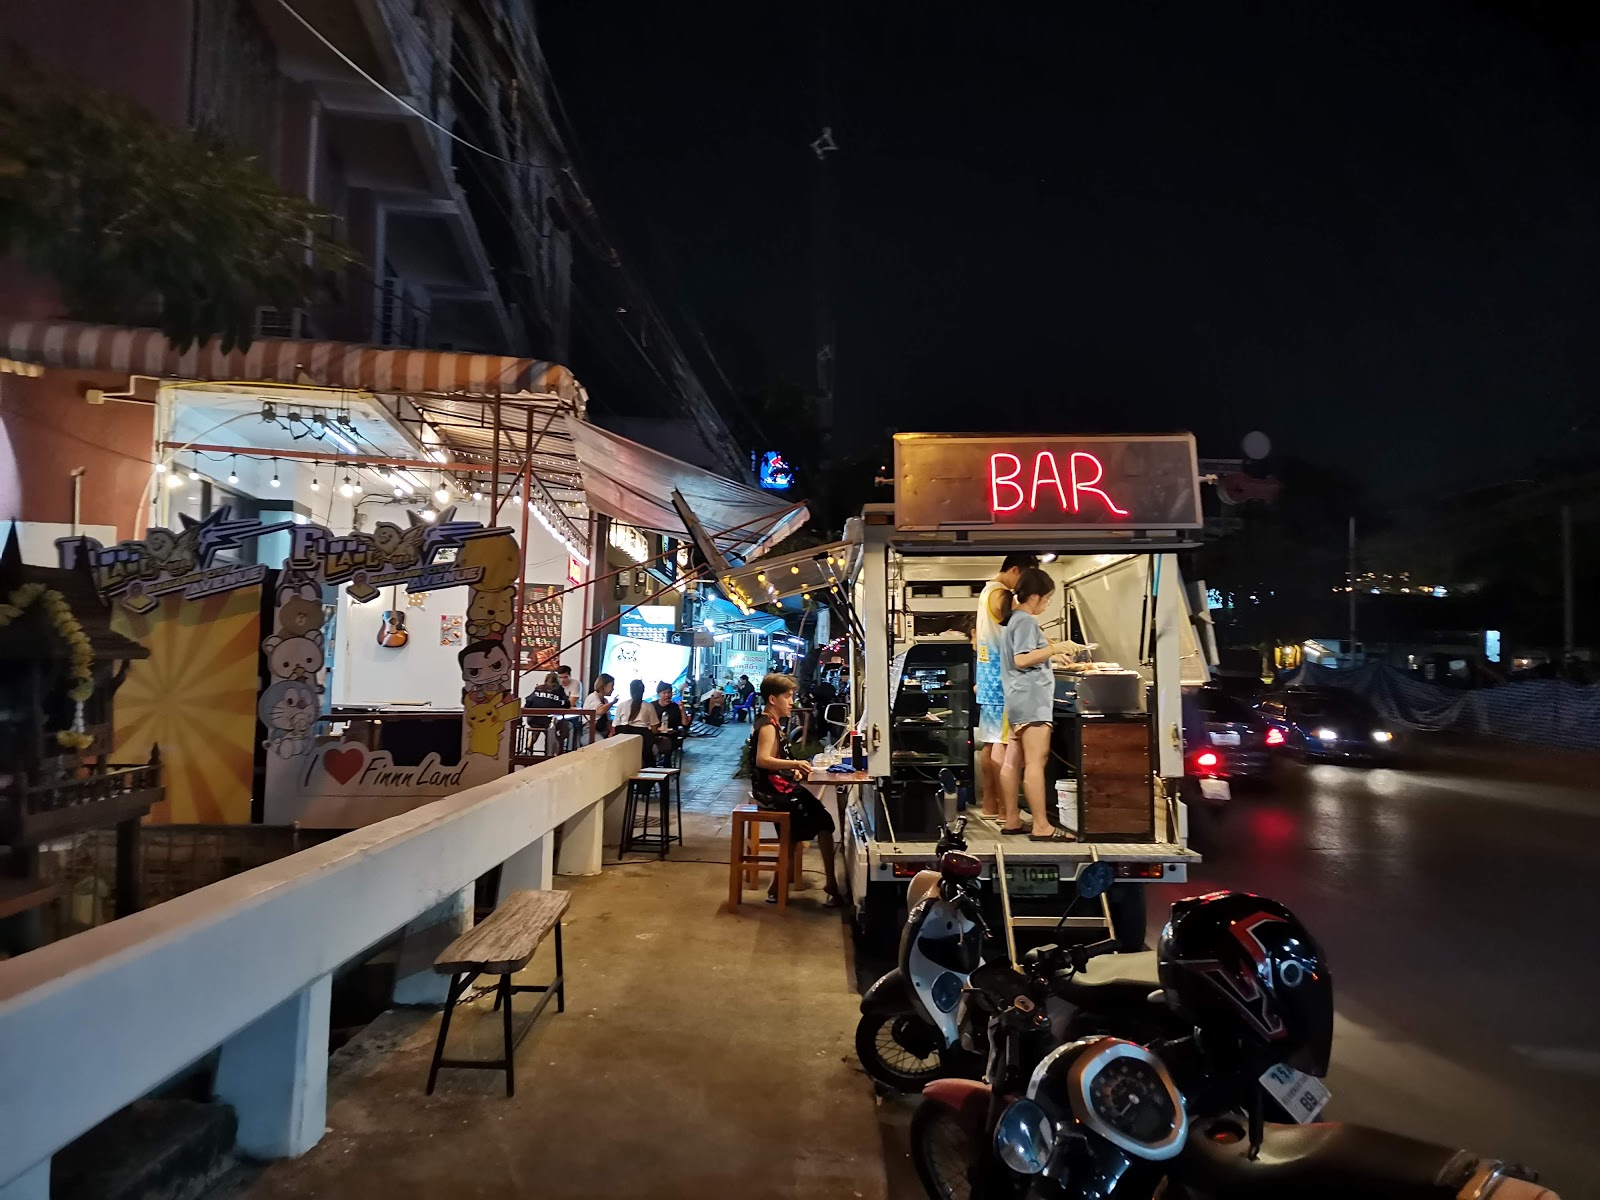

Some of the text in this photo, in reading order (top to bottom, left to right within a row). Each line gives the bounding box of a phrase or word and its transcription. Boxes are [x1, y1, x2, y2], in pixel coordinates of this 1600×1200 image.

[989, 450, 1129, 516] BAR
[189, 566, 264, 593] AVENUE
[410, 567, 479, 588] AVENUE
[304, 754, 469, 787] I Finnn Land
